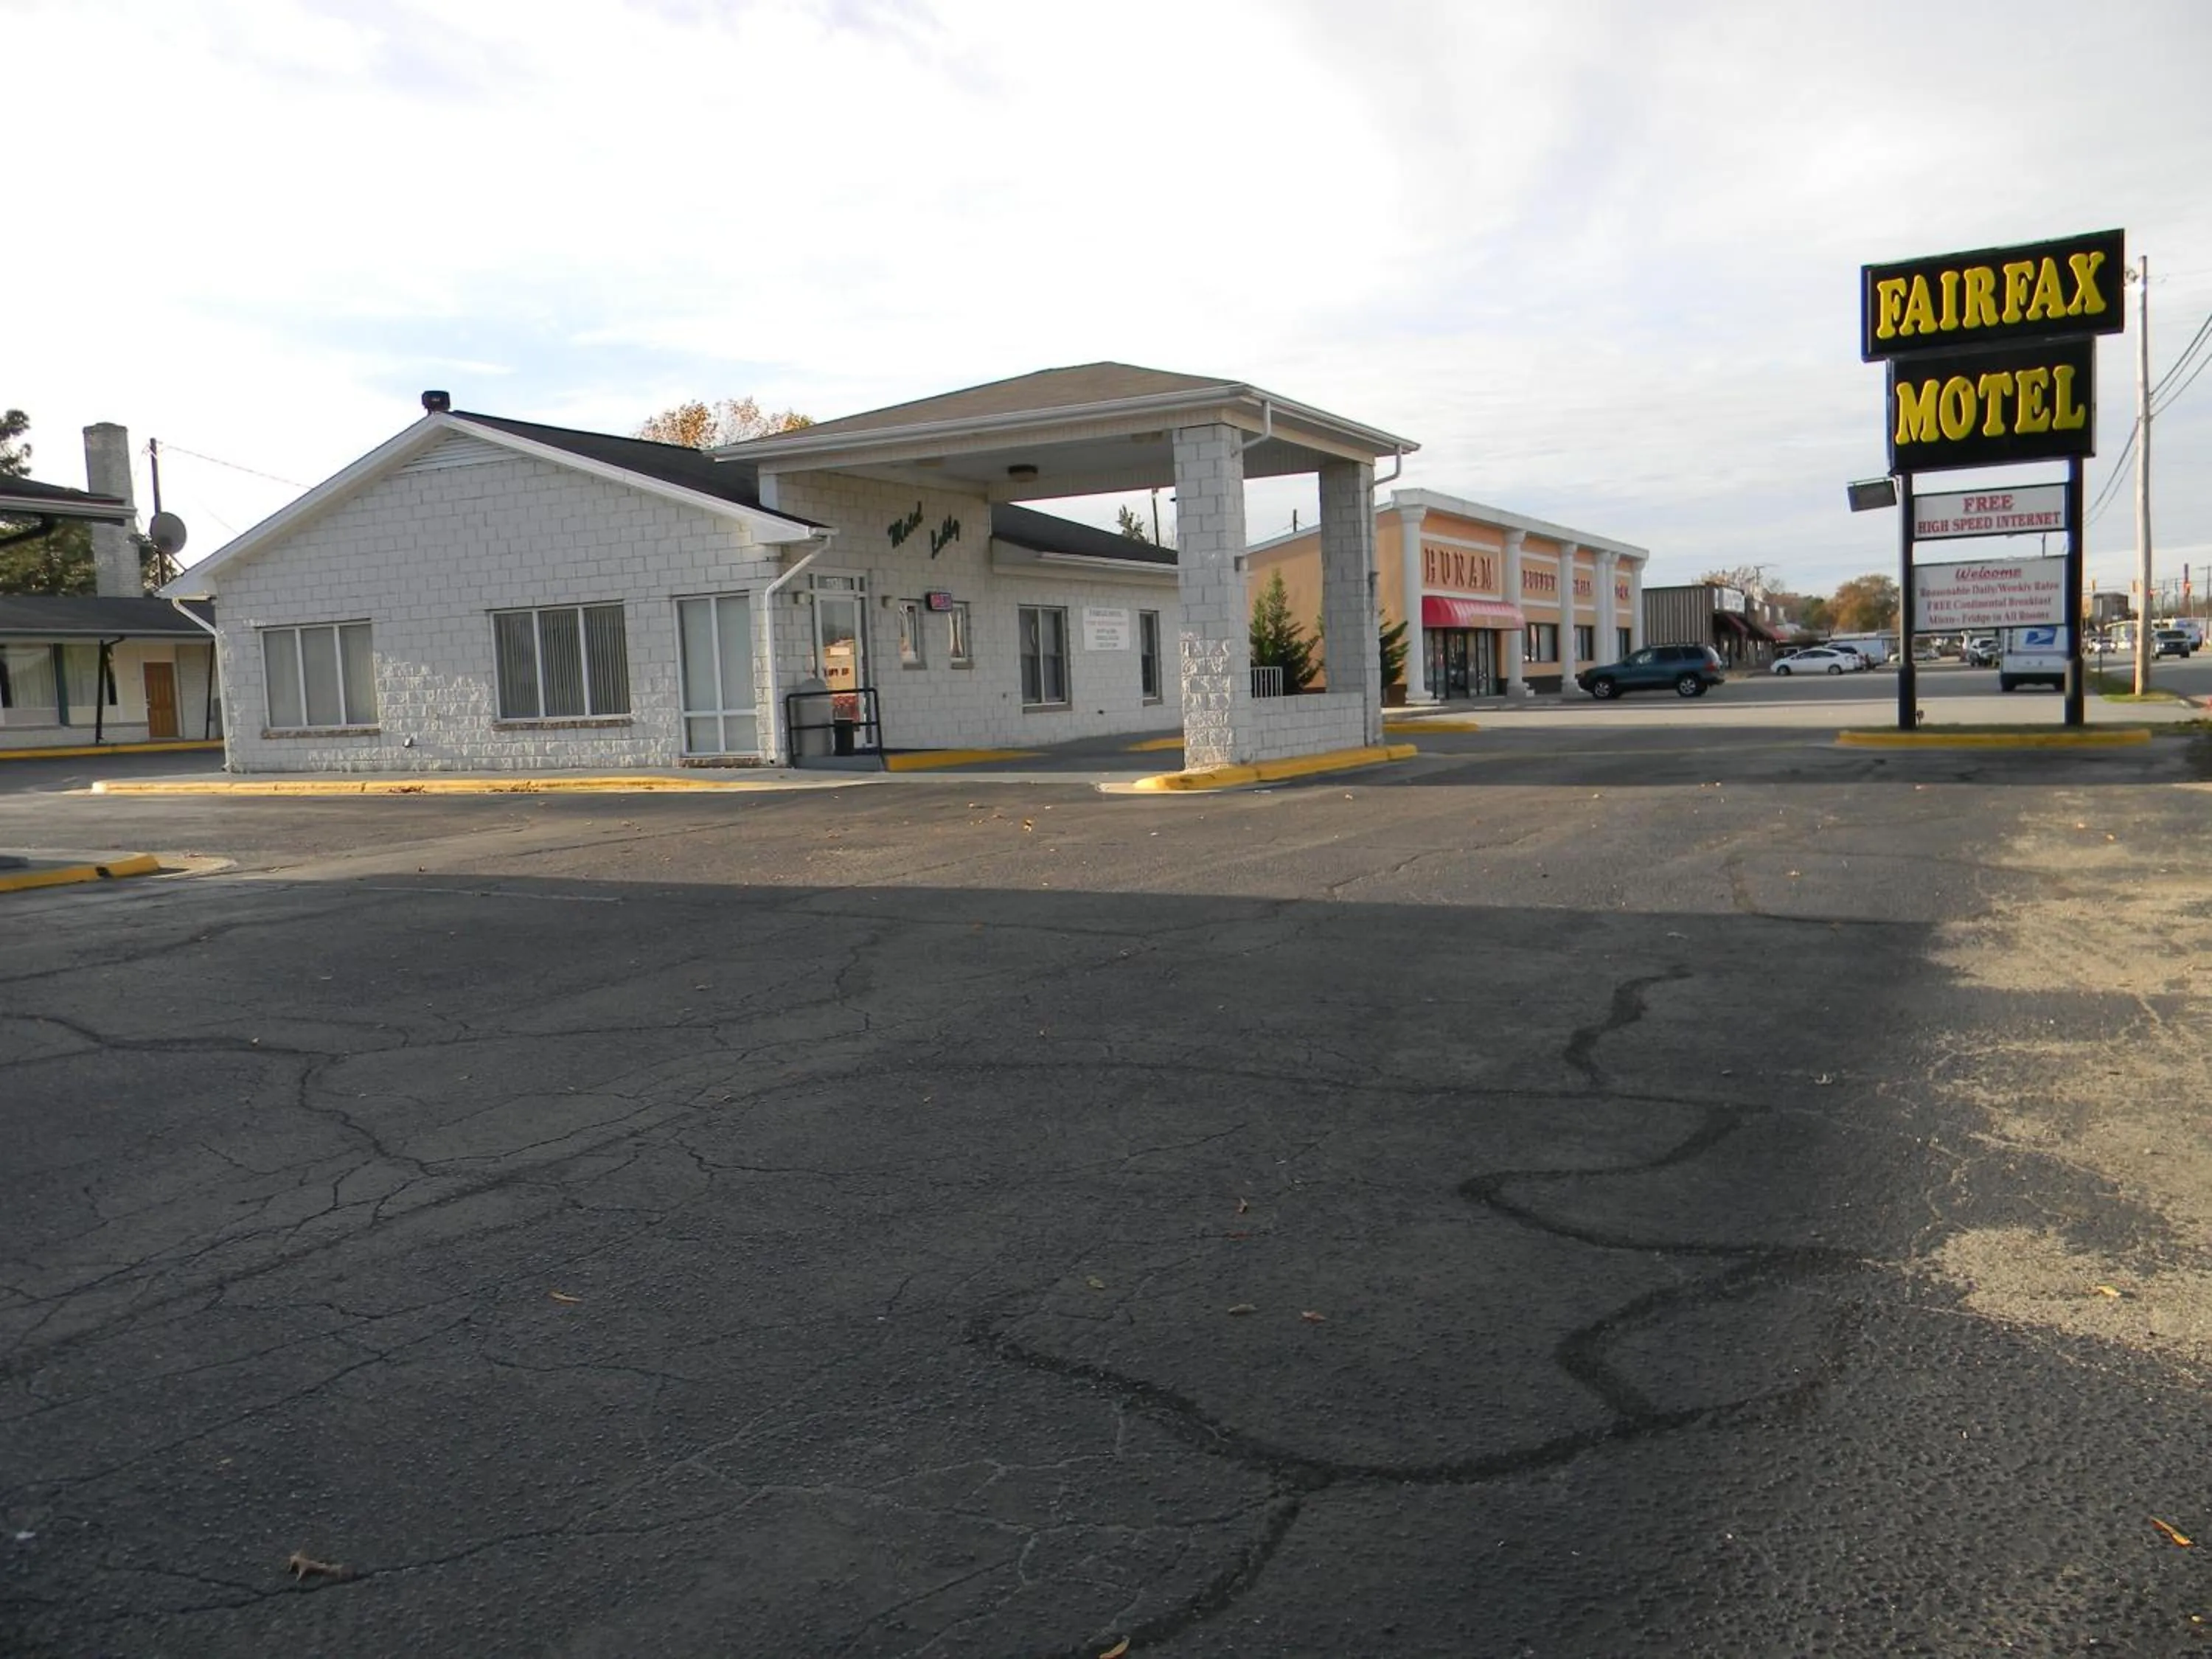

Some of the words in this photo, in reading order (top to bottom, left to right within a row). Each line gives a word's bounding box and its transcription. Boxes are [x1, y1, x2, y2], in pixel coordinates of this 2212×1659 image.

[1877, 251, 2107, 339] FAIRFAX
[1895, 365, 2085, 445] MOTEL
[1963, 494, 2014, 513] FREE
[1917, 519, 1949, 534] HIGH
[1952, 516, 1993, 532] SPEED
[1996, 512, 2061, 528] INTERNET
[1425, 548, 1495, 591] HUNAN
[1955, 566, 2023, 581] Welcome
[1954, 597, 2007, 611] Continental
